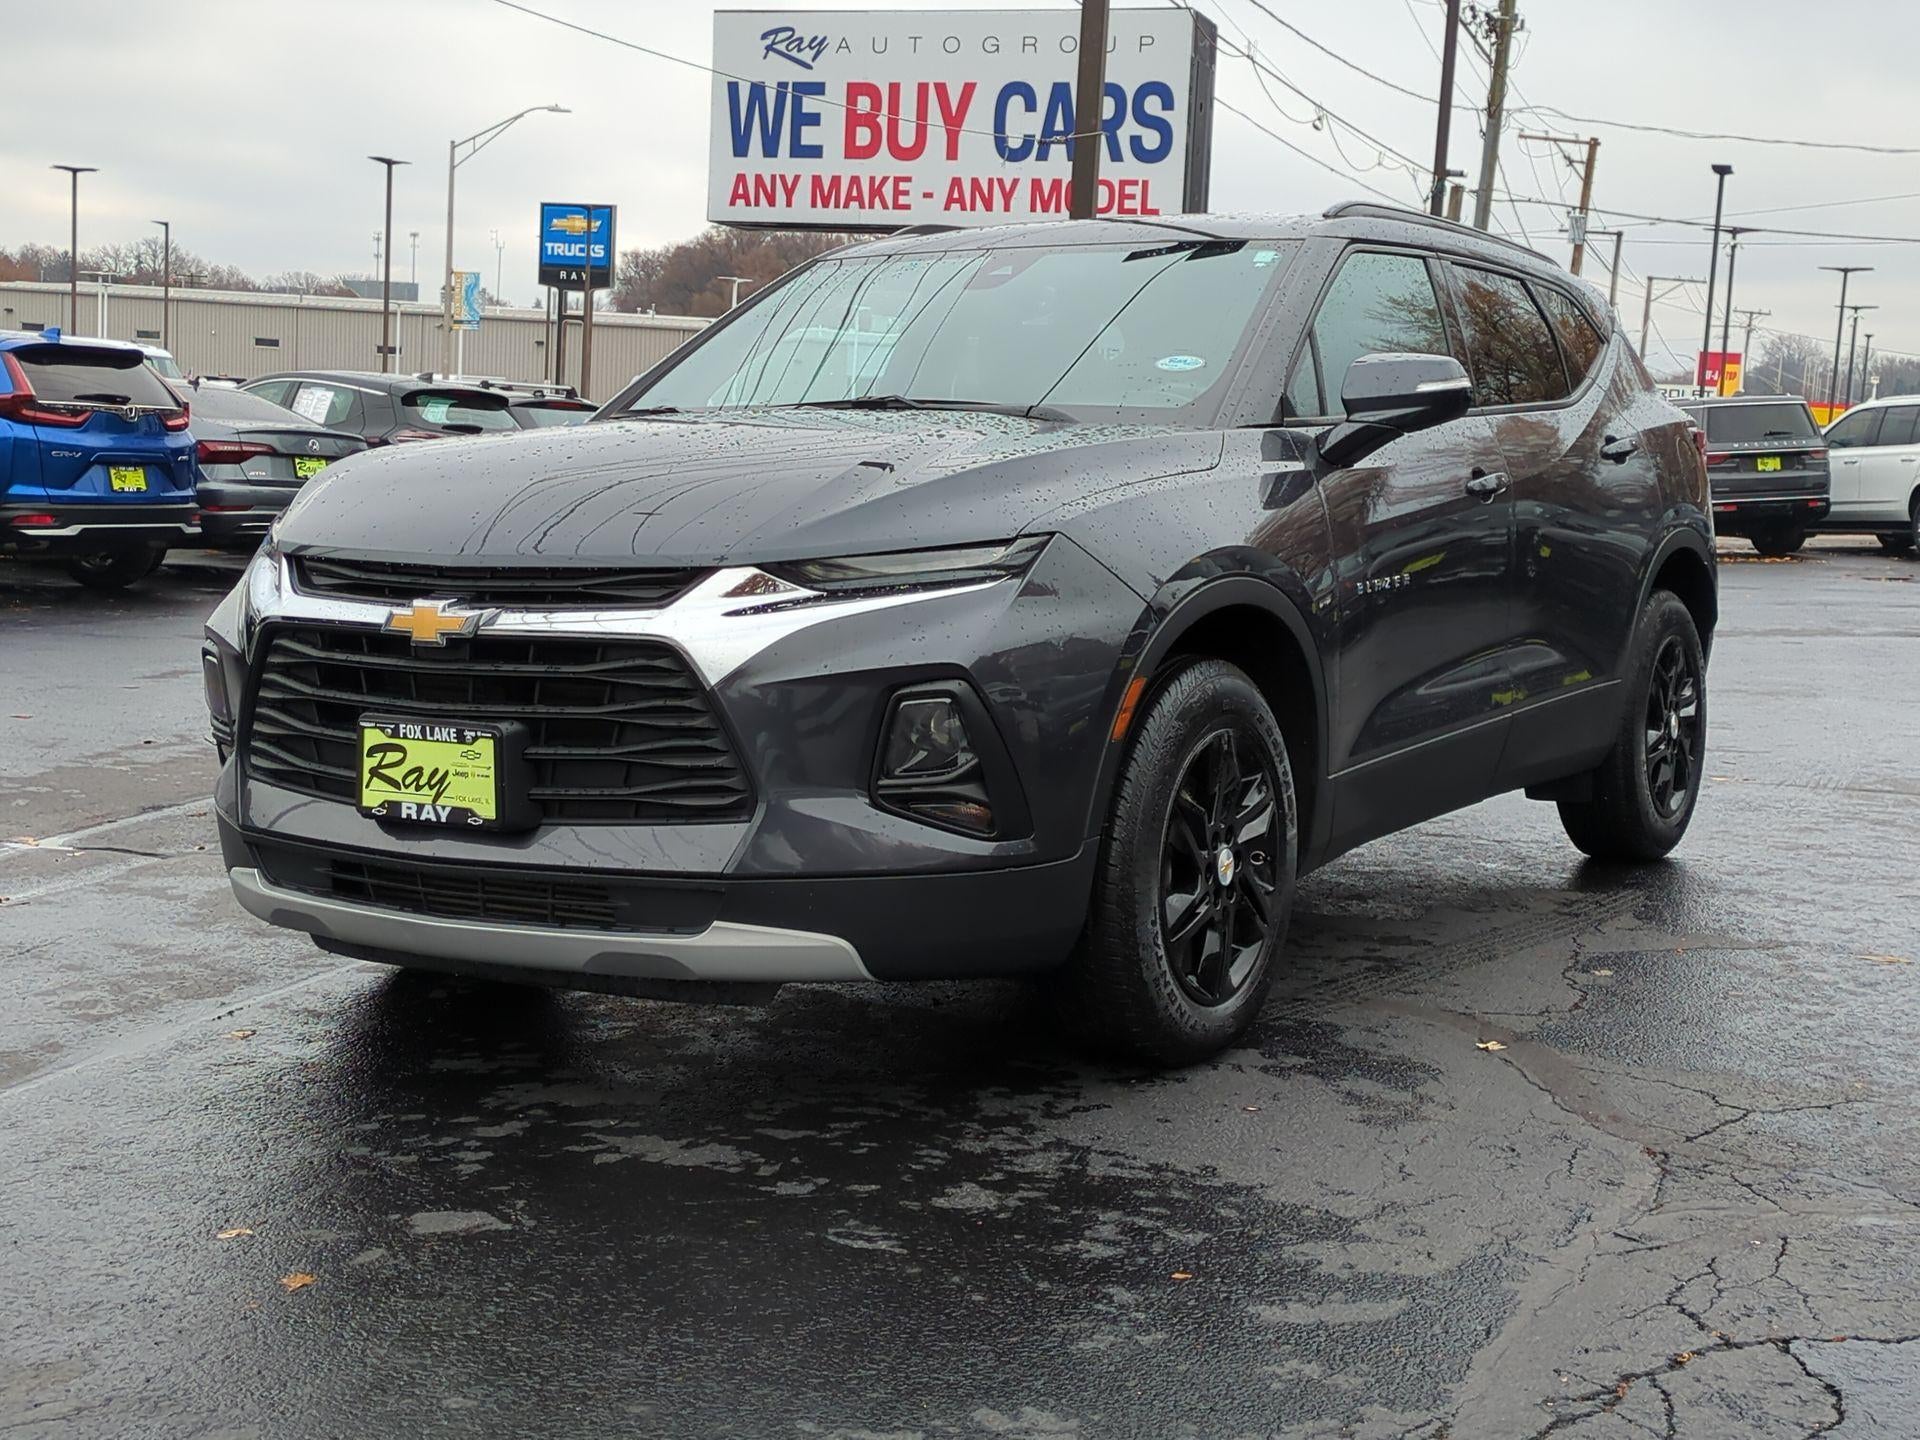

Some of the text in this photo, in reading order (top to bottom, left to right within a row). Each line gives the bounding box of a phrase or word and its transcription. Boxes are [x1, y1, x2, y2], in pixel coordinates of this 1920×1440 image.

[760, 26, 829, 70] Ray
[727, 81, 1174, 164] WE BUY CARS
[729, 173, 801, 208] ANY
[810, 174, 912, 210] MAKE
[943, 177, 1020, 212] ANY
[545, 242, 605, 258] TRUCKS
[560, 270, 588, 280] RAY
[51, 450, 82, 458] CR-V
[400, 724, 458, 743] FOX LAKE
[365, 743, 451, 804] Ray
[401, 802, 452, 823] RAY
